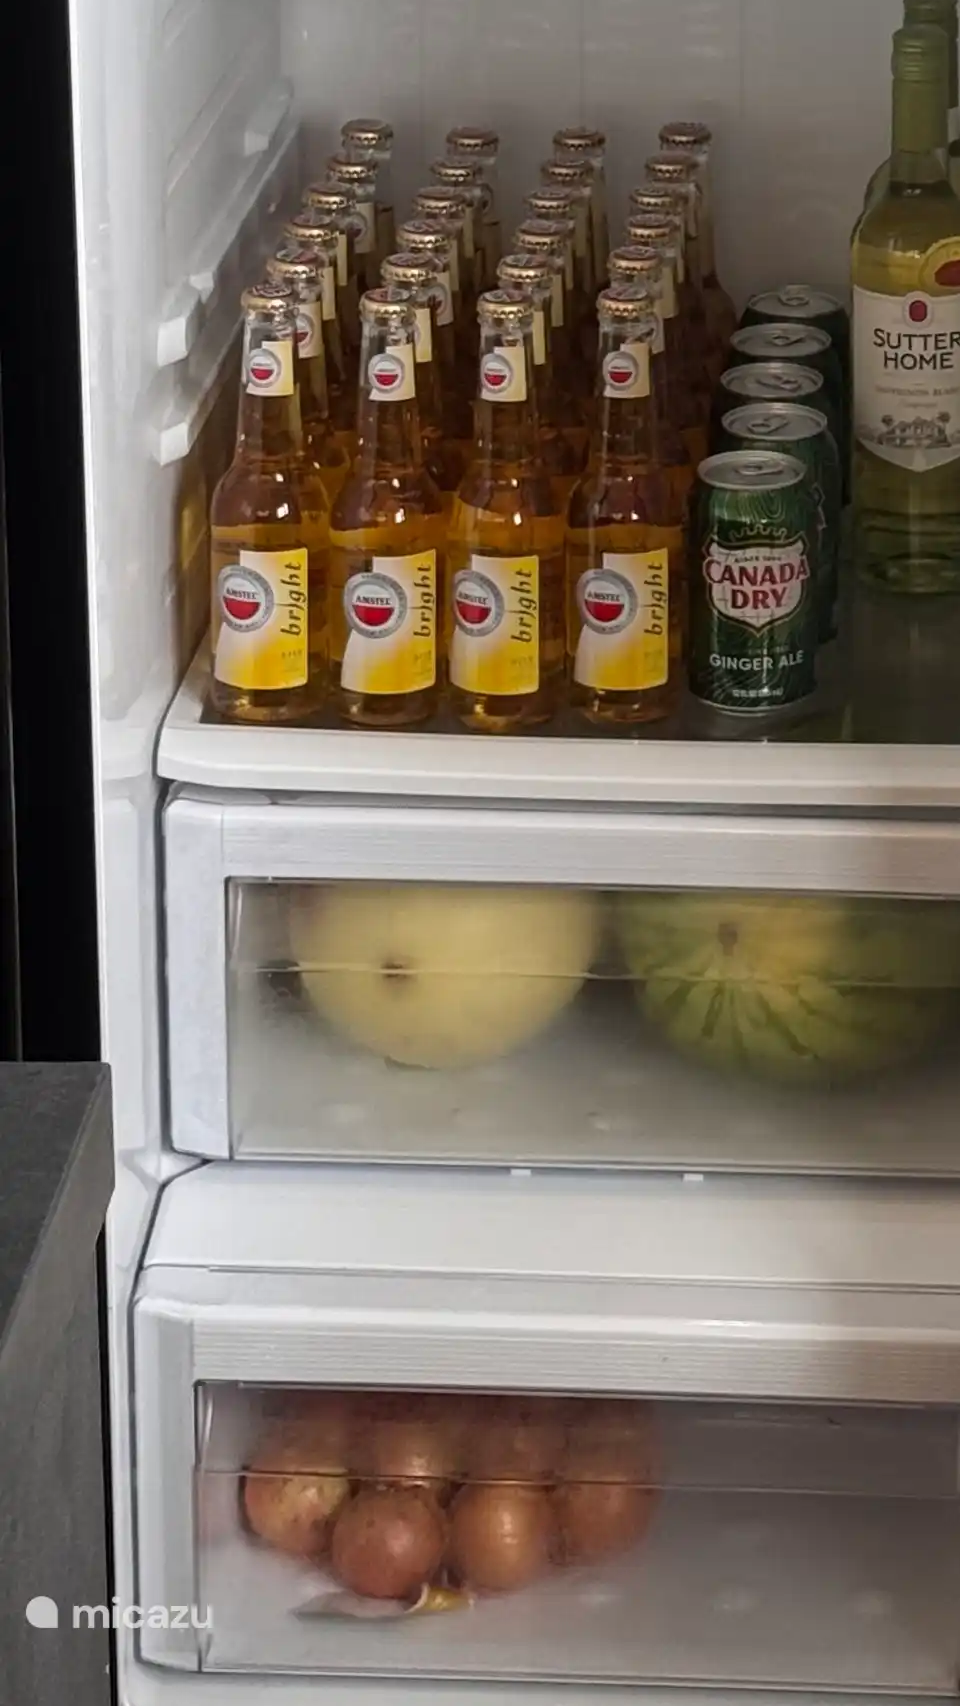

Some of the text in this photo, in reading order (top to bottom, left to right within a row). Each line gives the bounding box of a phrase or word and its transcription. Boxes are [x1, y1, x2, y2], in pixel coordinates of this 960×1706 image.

[883, 351, 954, 371] HOME
[705, 558, 809, 586] CANADA
[225, 587, 257, 600] AMSTEL
[280, 562, 307, 636] bright
[356, 595, 391, 606] AMSTEL
[414, 564, 434, 638] bright
[511, 568, 537, 643] bright
[644, 562, 668, 636] bright
[731, 587, 788, 610] DRY
[709, 653, 774, 671] GINGER
[778, 650, 805, 668] ALE
